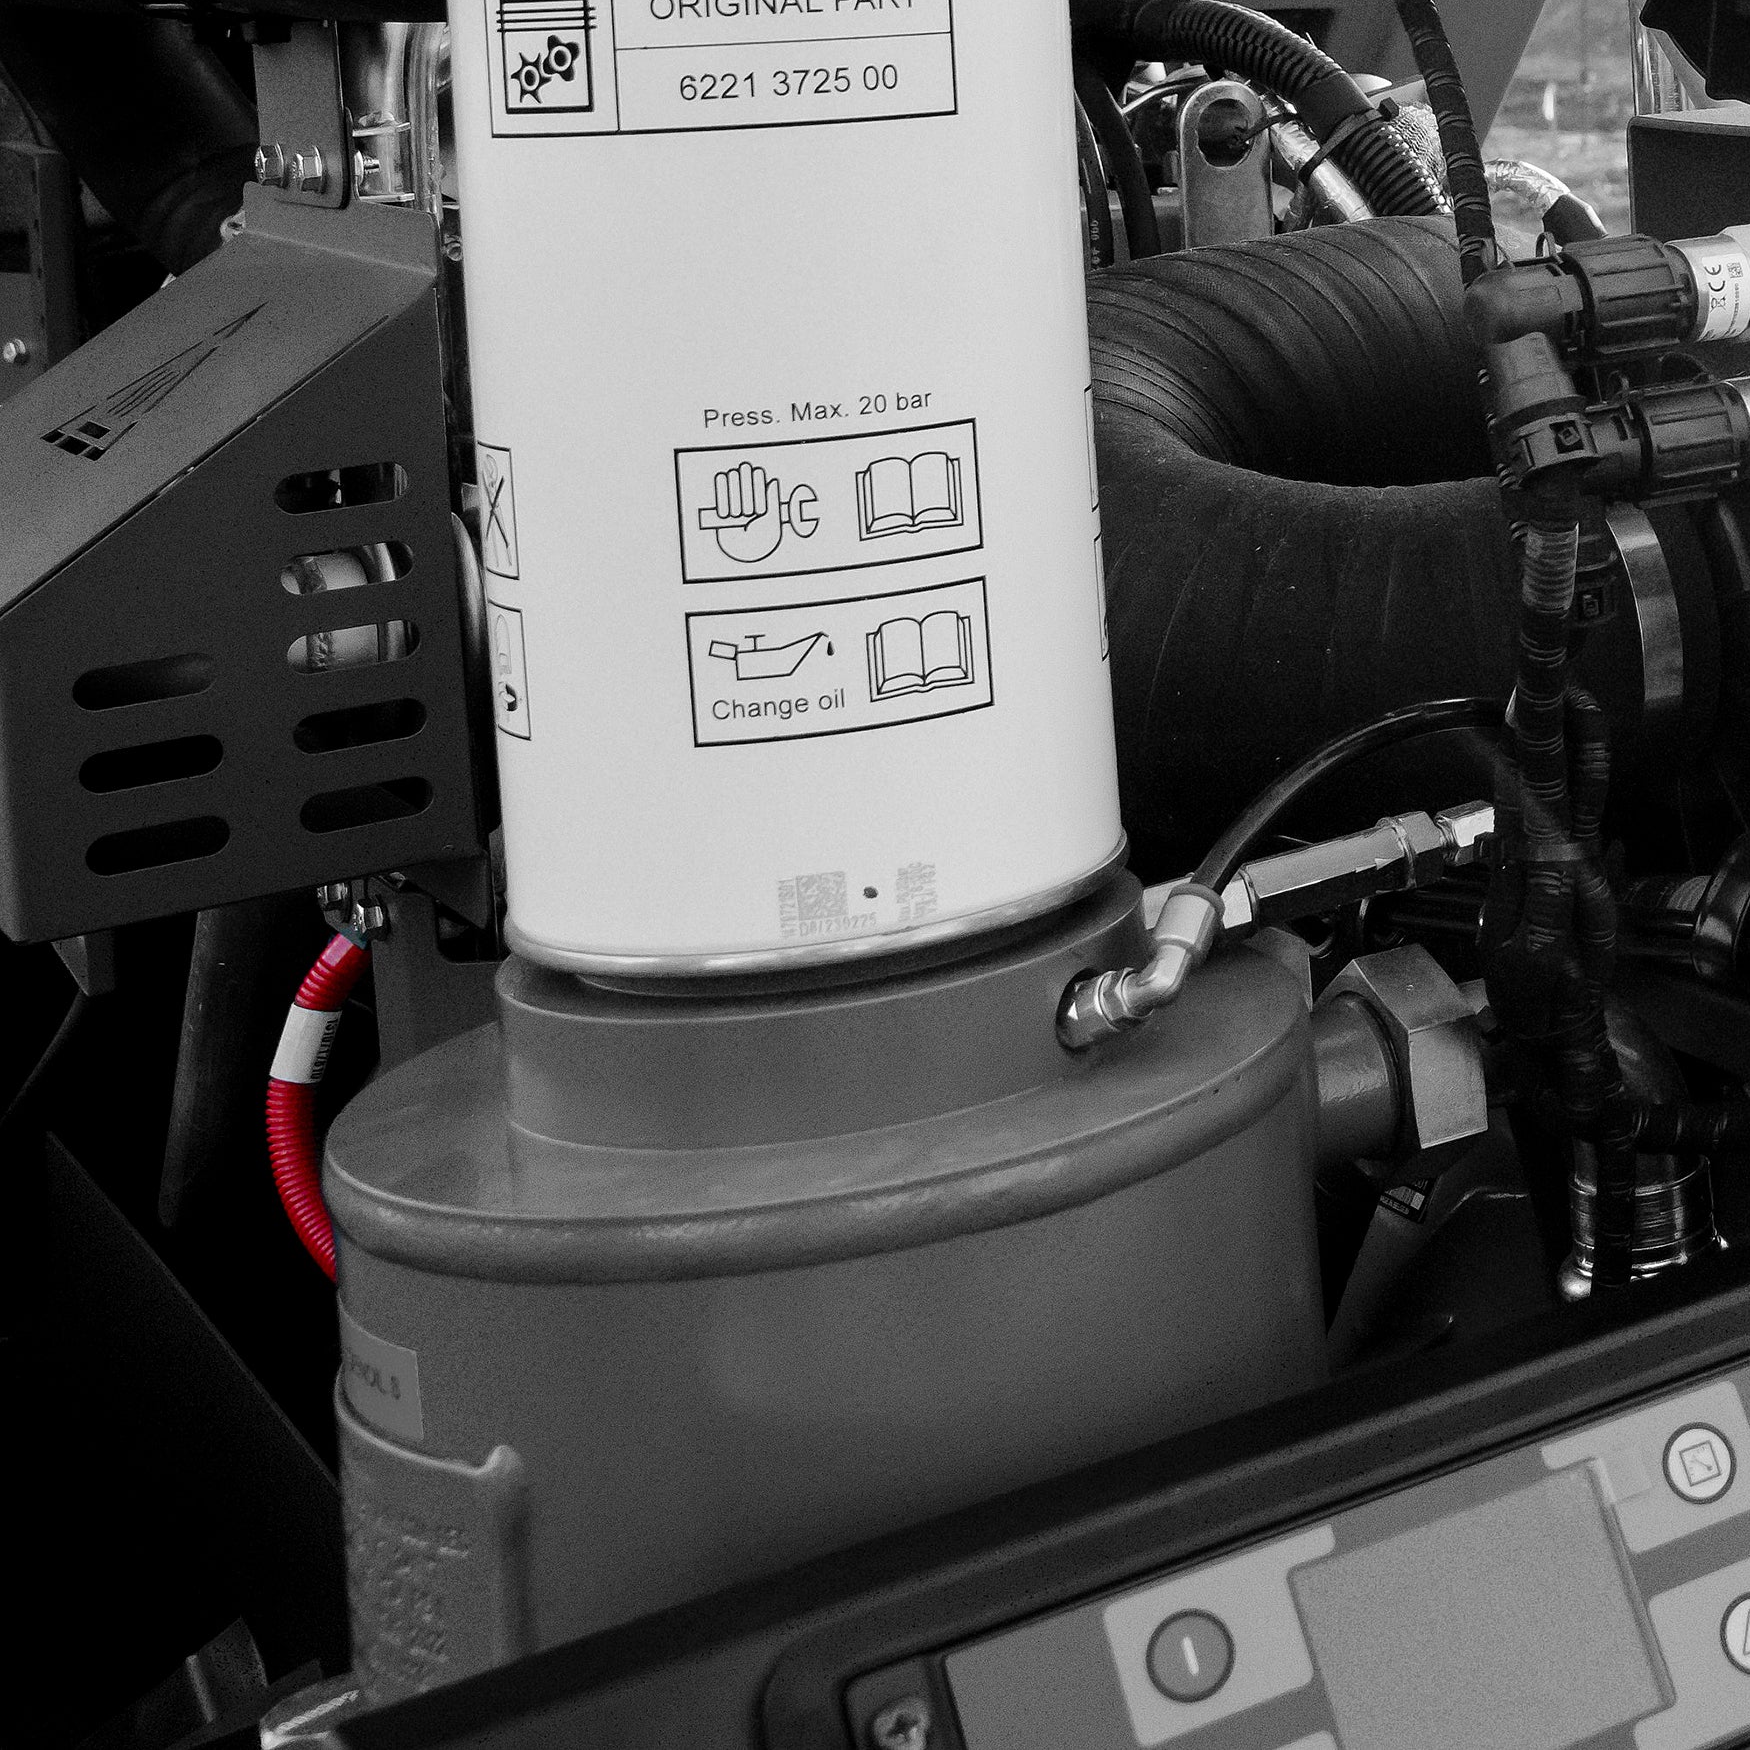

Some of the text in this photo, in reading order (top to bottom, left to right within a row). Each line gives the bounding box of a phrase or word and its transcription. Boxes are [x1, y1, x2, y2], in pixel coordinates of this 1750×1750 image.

[680, 64, 899, 102] 6221 3725 00
[703, 391, 932, 428] Press. Max. 20 bar
[712, 688, 847, 720] Change oil
